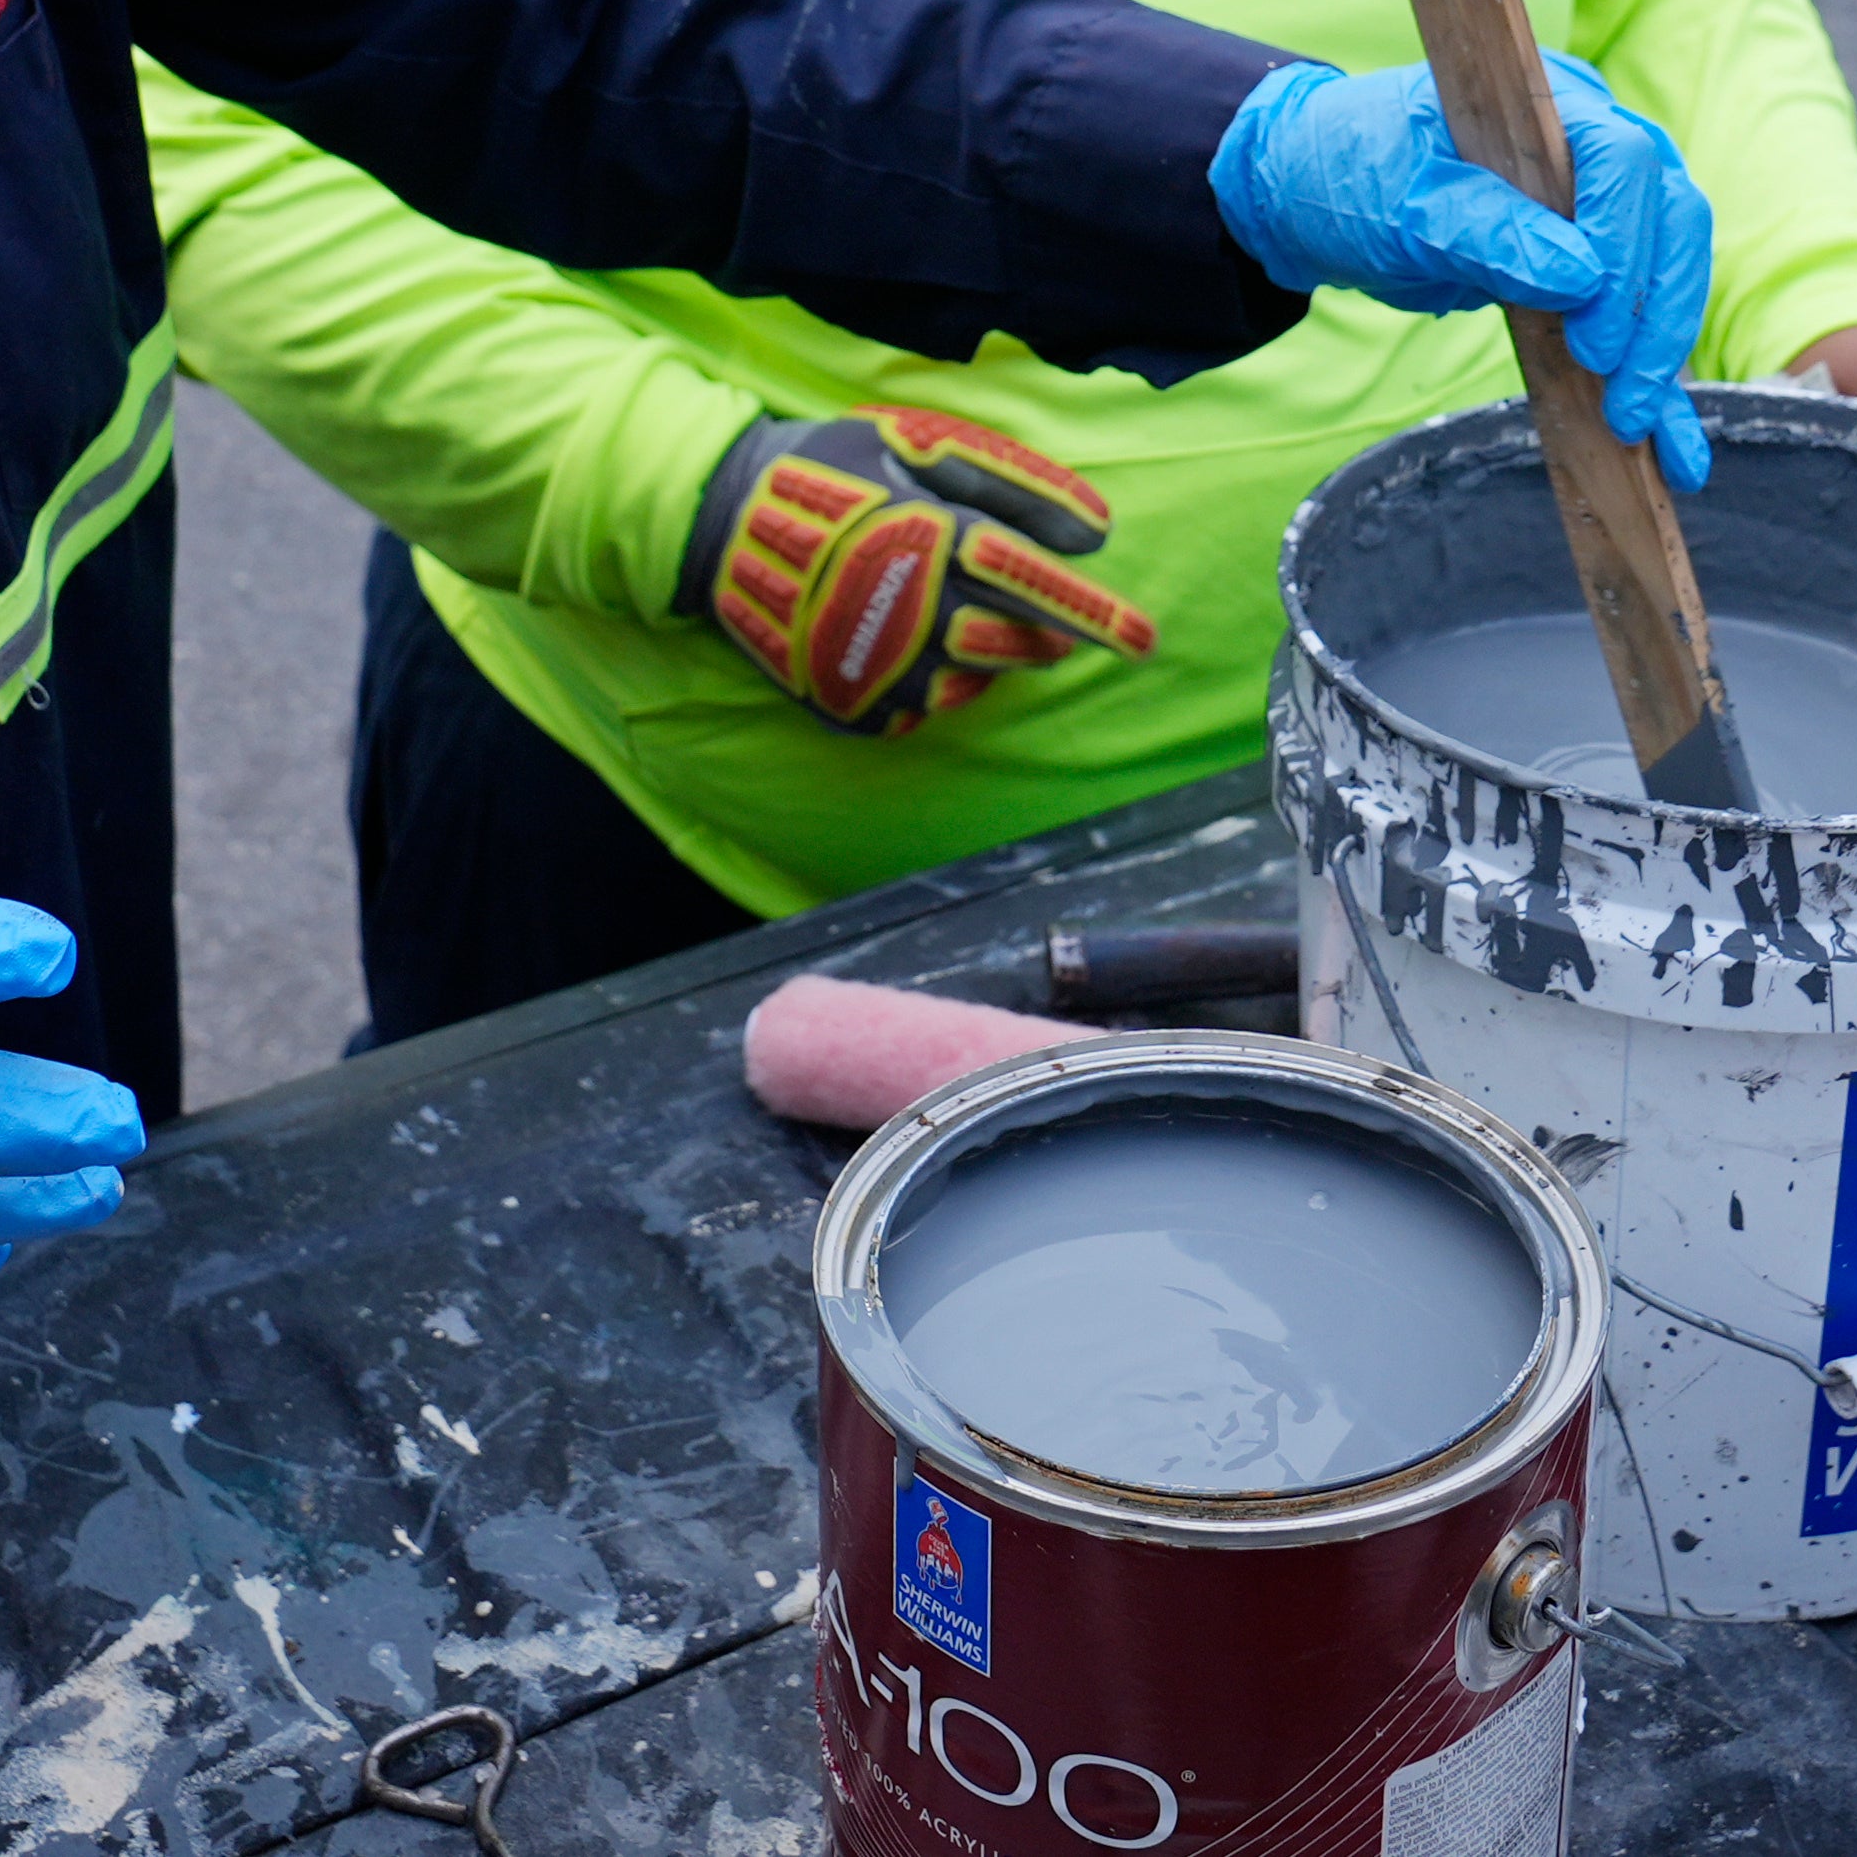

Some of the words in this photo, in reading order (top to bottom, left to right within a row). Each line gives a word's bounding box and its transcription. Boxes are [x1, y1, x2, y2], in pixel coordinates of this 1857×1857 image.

[898, 1573, 983, 1641] SHERWIN
[898, 1590, 984, 1663] WILLIAMS
[823, 1568, 1179, 1851] A-100
[864, 1753, 911, 1811] 100%
